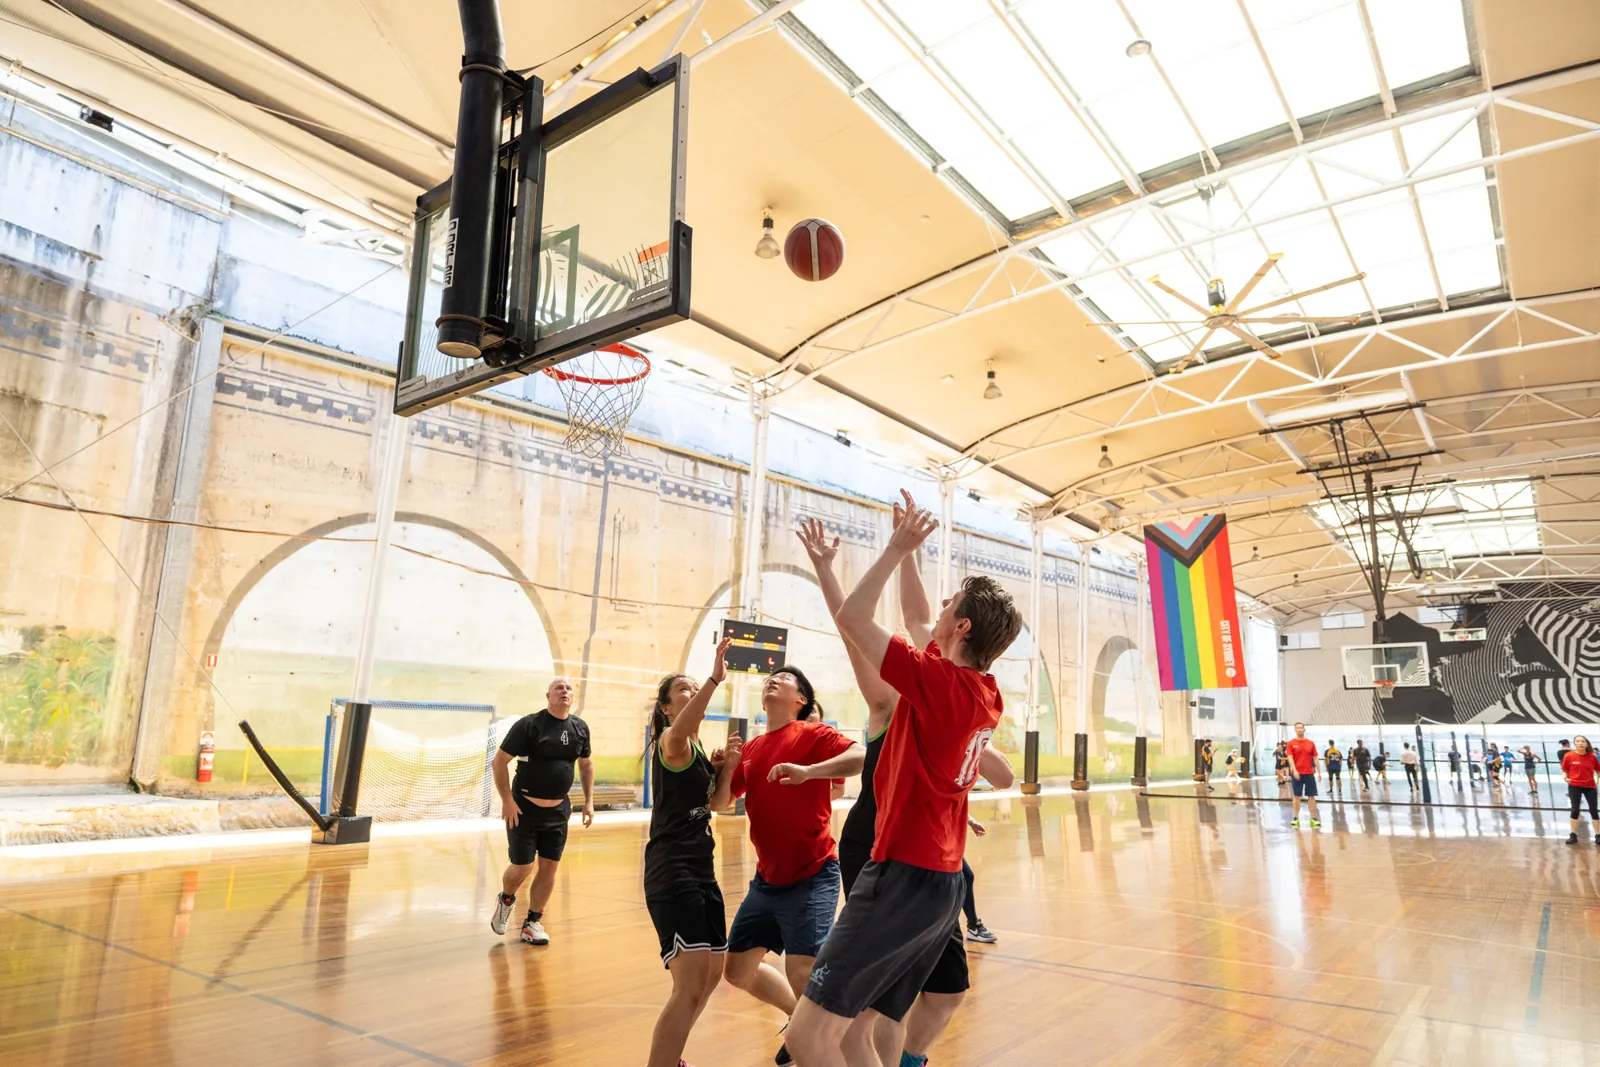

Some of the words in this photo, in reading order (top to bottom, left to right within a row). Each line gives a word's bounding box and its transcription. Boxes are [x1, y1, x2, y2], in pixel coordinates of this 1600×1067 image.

[1220, 620, 1231, 635] CITY
[1221, 635, 1232, 643] OF
[1222, 643, 1235, 667] SYDNEY
[560, 730, 569, 746] 4
